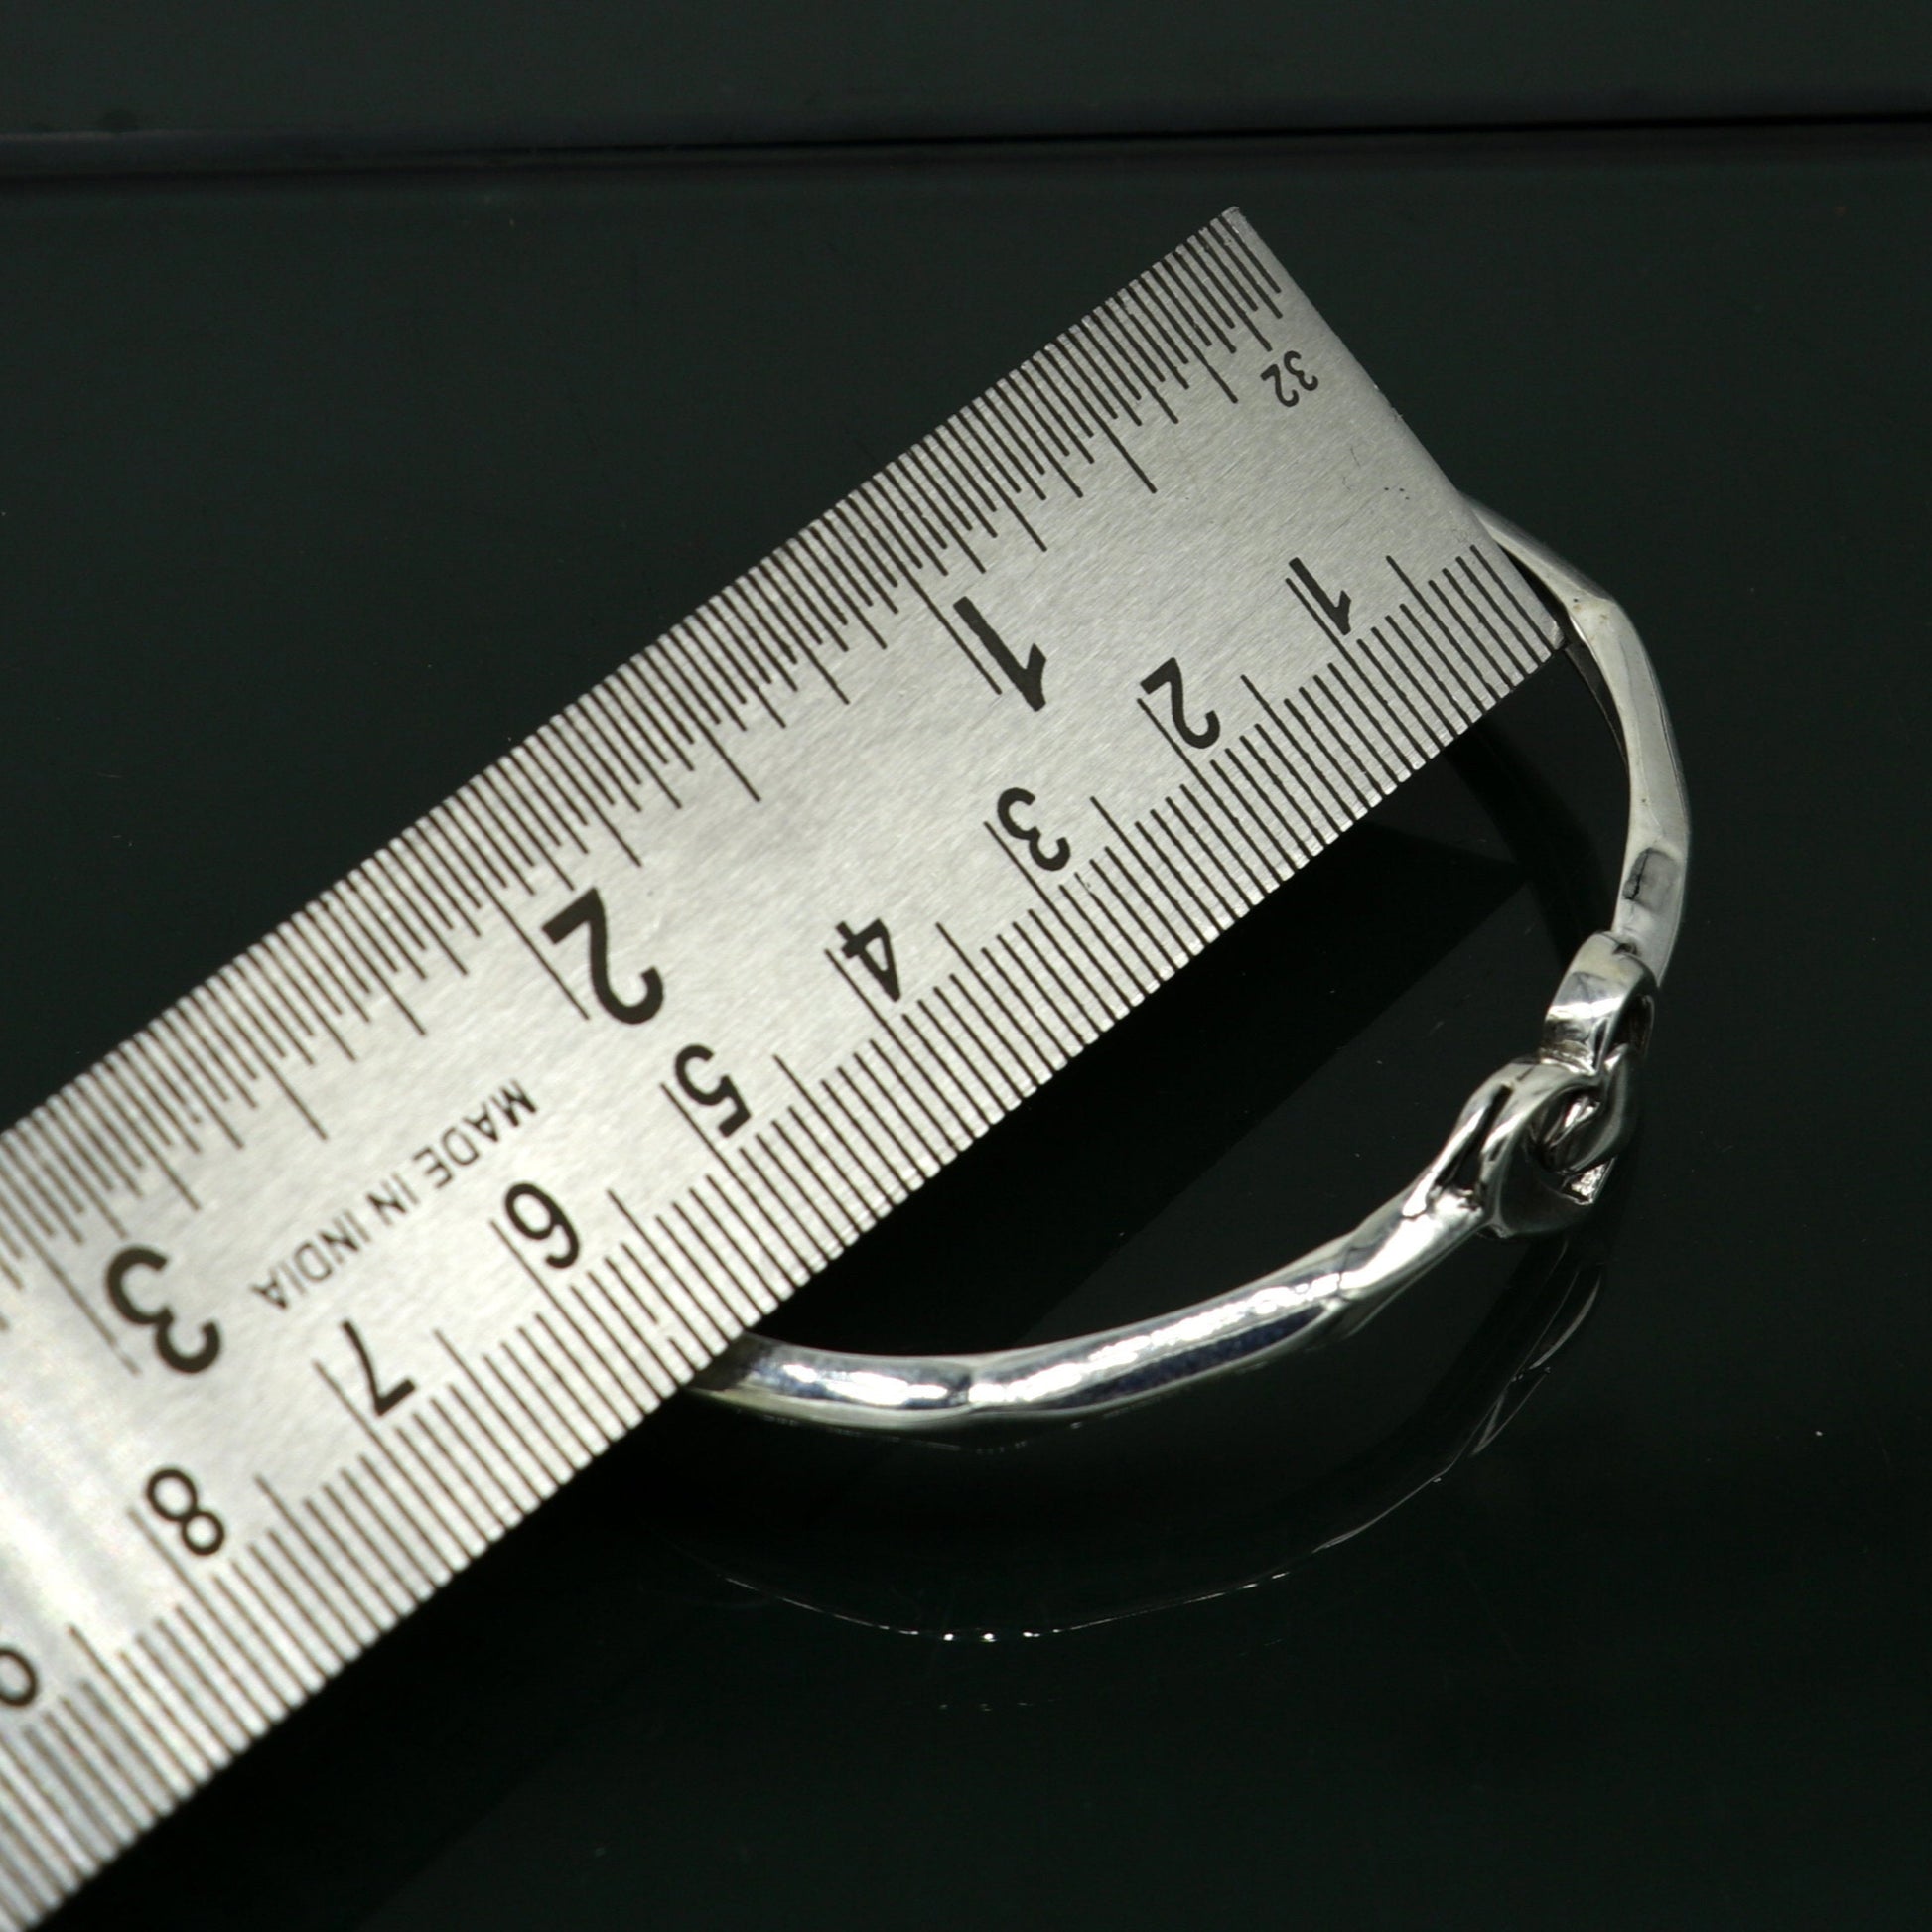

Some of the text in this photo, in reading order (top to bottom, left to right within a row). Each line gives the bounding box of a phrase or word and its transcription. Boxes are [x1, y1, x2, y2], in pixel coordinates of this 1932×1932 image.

[1260, 350, 1318, 408] 32
[1289, 557, 1351, 635] 1
[953, 597, 1046, 712] 1
[1141, 657, 1221, 749] 2
[997, 787, 1071, 872] 3
[541, 887, 664, 1025] 2
[836, 918, 900, 1003] 4
[675, 1044, 751, 1138] 5
[250, 1078, 537, 1310] MADE IN INDIA
[504, 1182, 581, 1269] 6
[105, 1246, 222, 1374] 3
[342, 1320, 416, 1416] 7
[147, 1467, 225, 1556] 8
